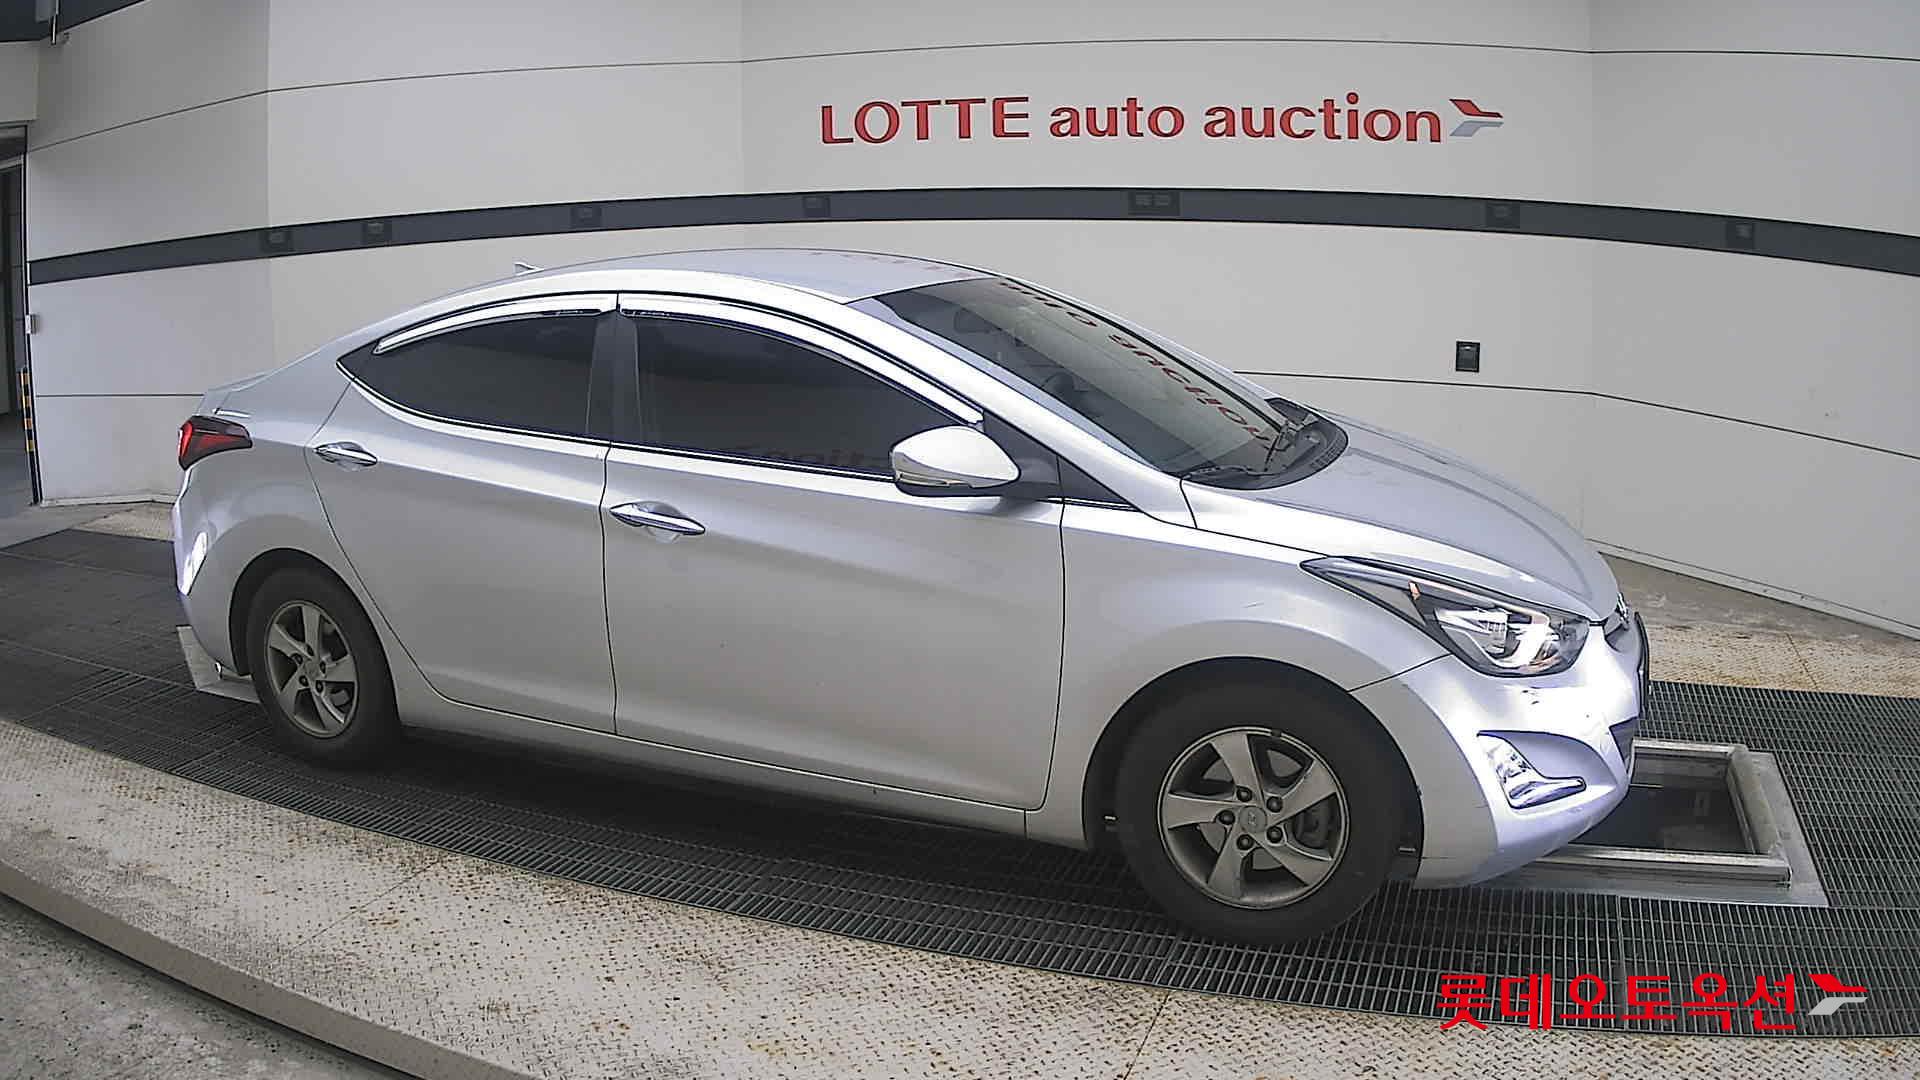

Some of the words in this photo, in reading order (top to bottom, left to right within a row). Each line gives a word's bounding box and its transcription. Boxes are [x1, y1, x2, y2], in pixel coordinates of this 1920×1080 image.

[820, 97, 1029, 144] LOTTE
[1049, 97, 1185, 138] auto
[1203, 92, 1442, 143] auction
